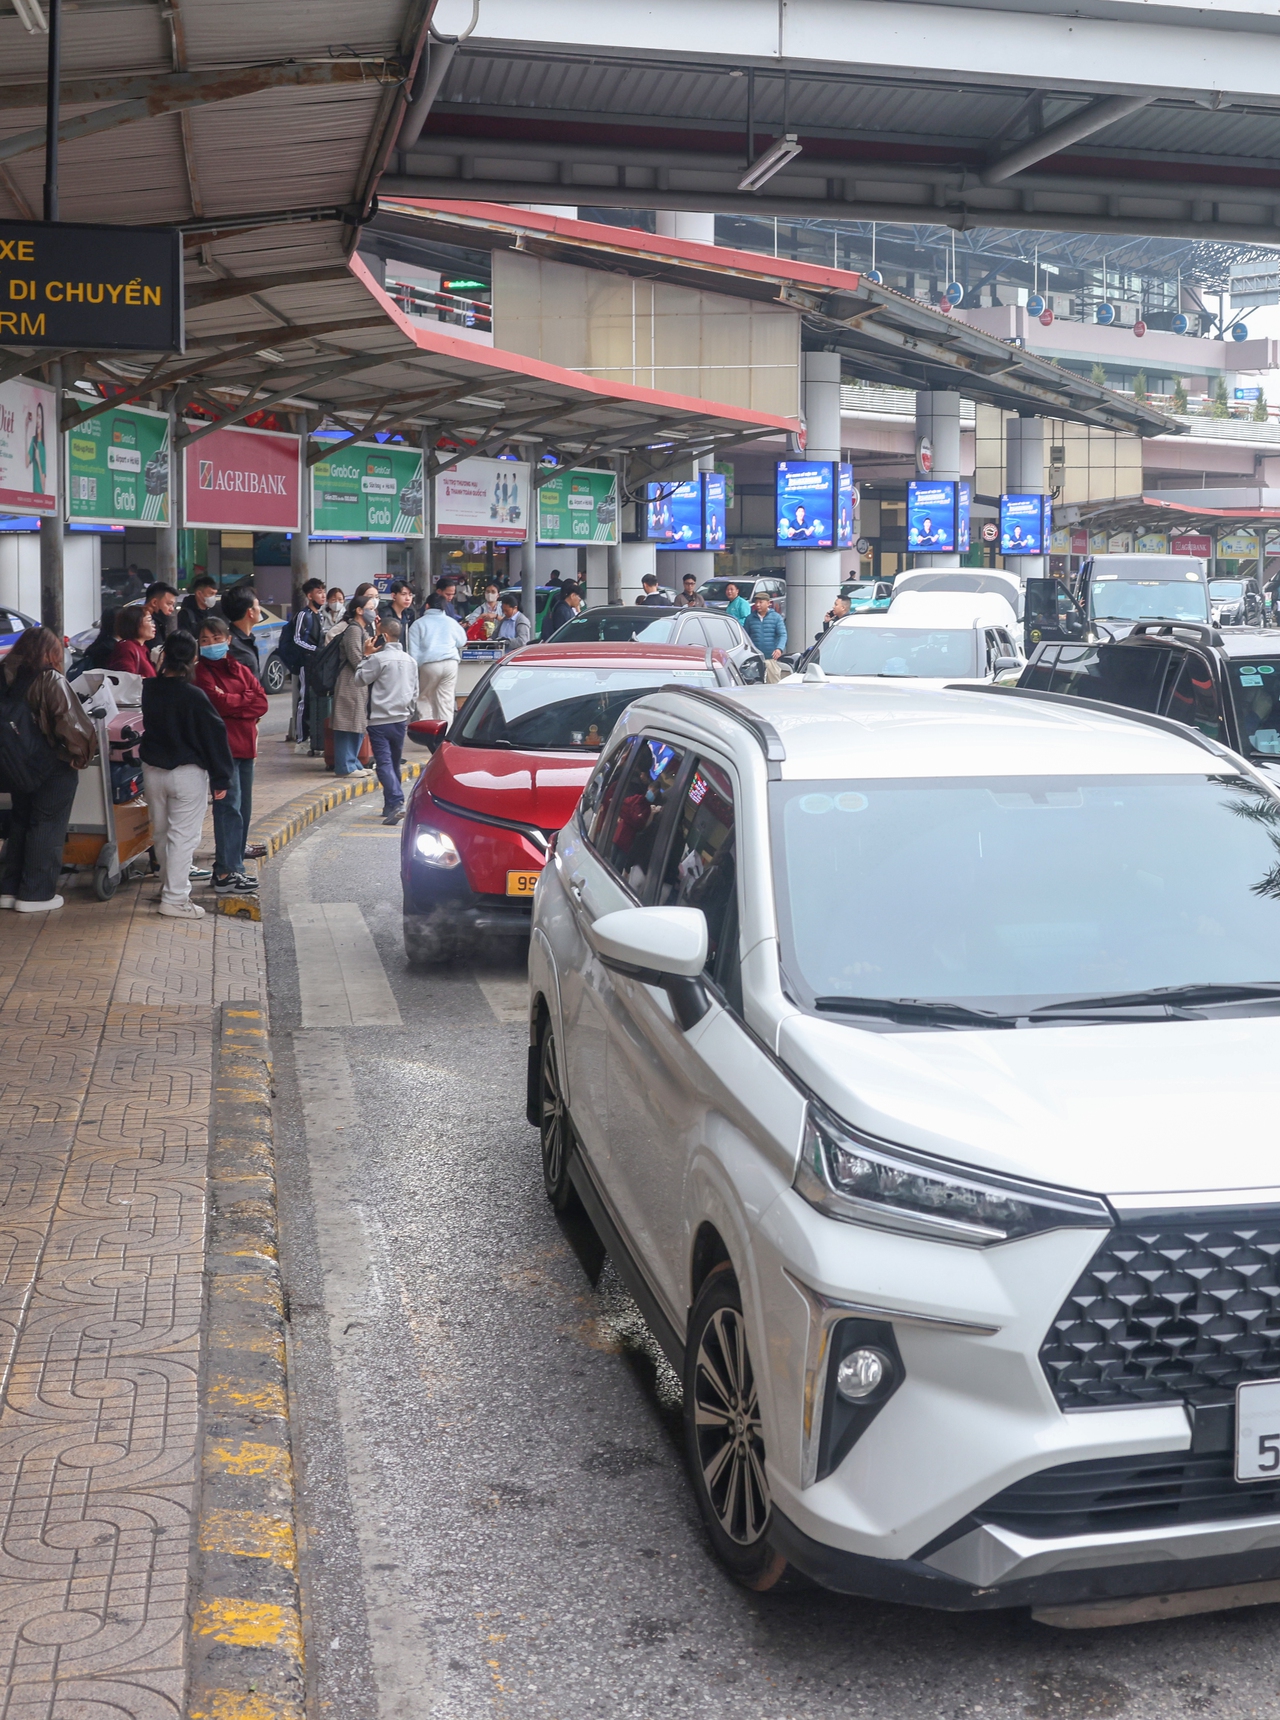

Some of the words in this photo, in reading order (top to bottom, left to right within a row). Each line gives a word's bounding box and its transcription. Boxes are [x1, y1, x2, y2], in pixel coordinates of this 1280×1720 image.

[0, 240, 35, 261] XE
[10, 279, 36, 300] DI
[45, 277, 161, 306] CHUYỂN
[330, 464, 360, 479] GrabCar
[215, 470, 287, 495] AGRIBANK
[114, 487, 136, 511] Grab
[368, 507, 391, 525] Grab
[572, 519, 590, 535] Grab
